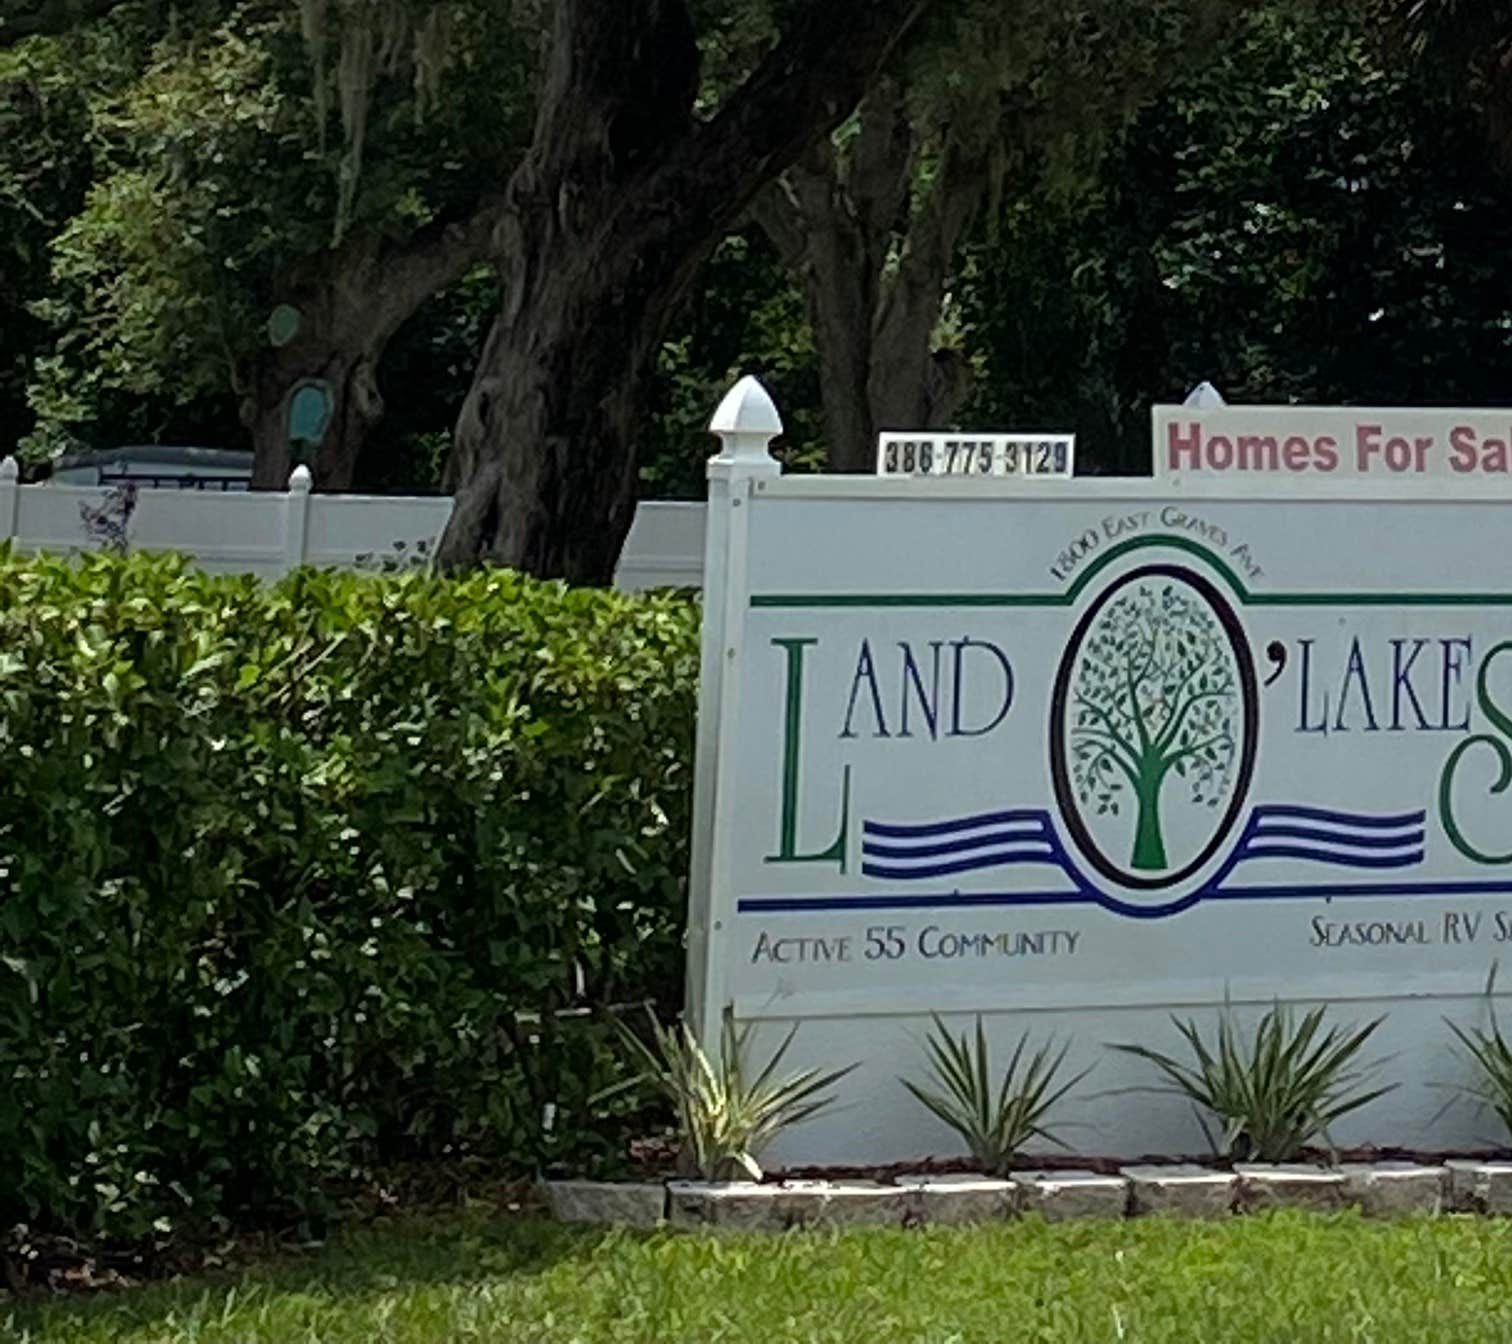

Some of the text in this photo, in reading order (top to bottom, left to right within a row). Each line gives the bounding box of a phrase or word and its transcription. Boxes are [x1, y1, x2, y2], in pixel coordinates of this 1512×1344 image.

[885, 440, 1068, 474] 386-775-3129
[1167, 422, 1339, 471] Homes
[1355, 424, 1433, 472] For
[1050, 528, 1100, 581] 1800
[864, 926, 906, 959] 55
[1442, 912, 1484, 944] RV
